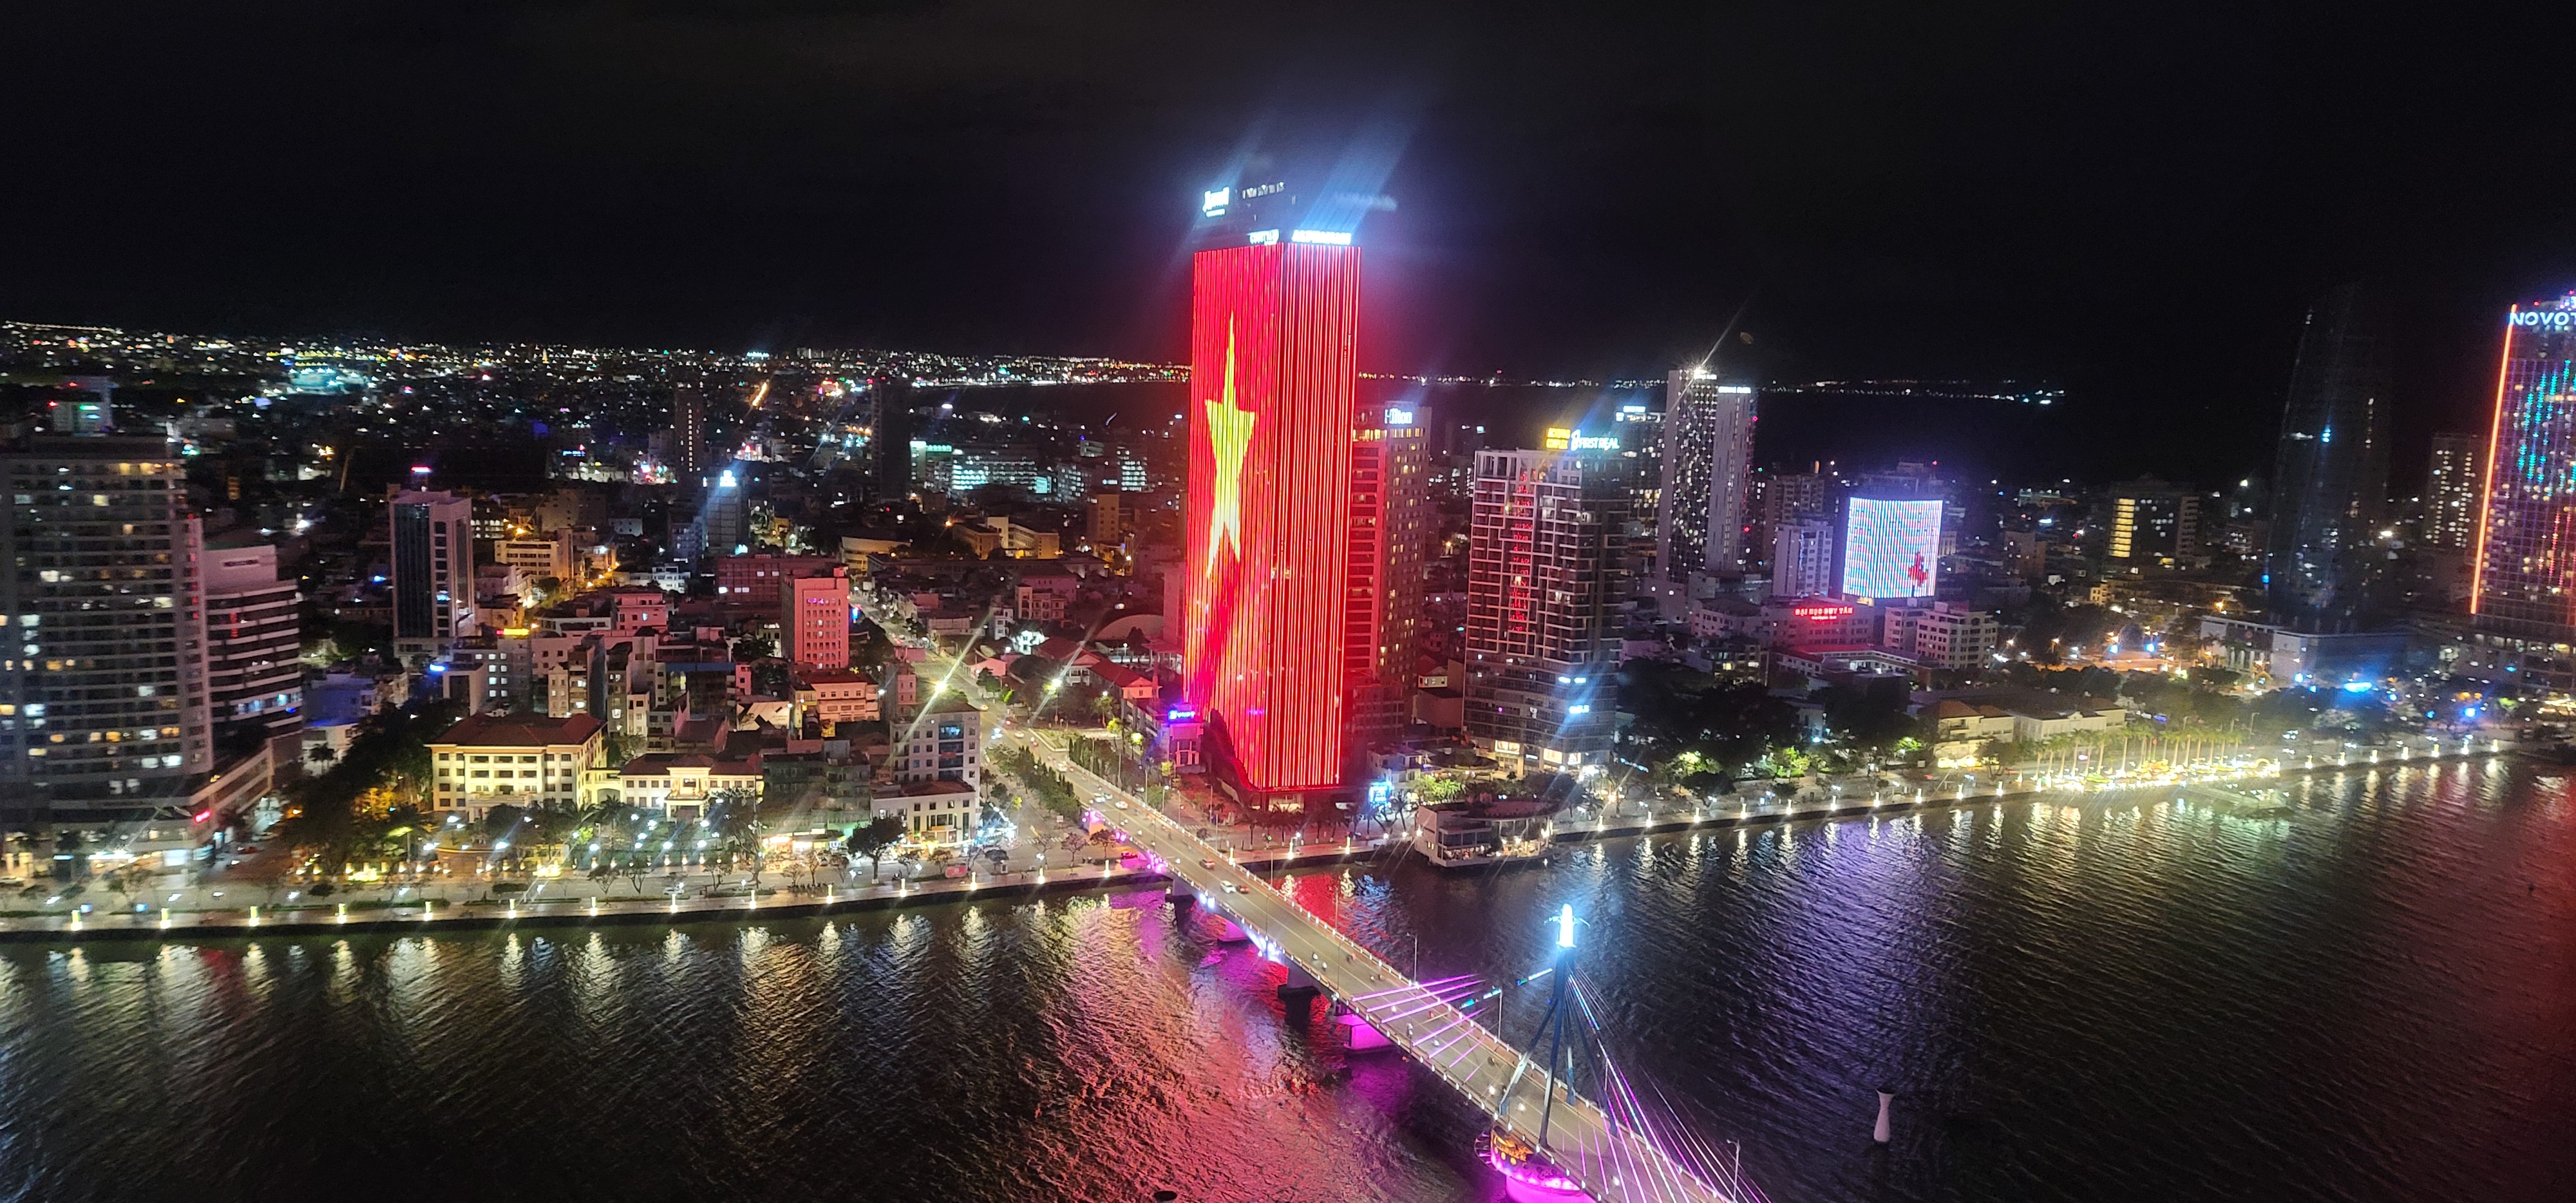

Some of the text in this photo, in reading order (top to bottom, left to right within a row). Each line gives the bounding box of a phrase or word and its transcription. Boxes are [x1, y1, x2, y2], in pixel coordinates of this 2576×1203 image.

[1385, 408, 1412, 424] Hilton
[1578, 437, 1620, 450] FIRST REAL
